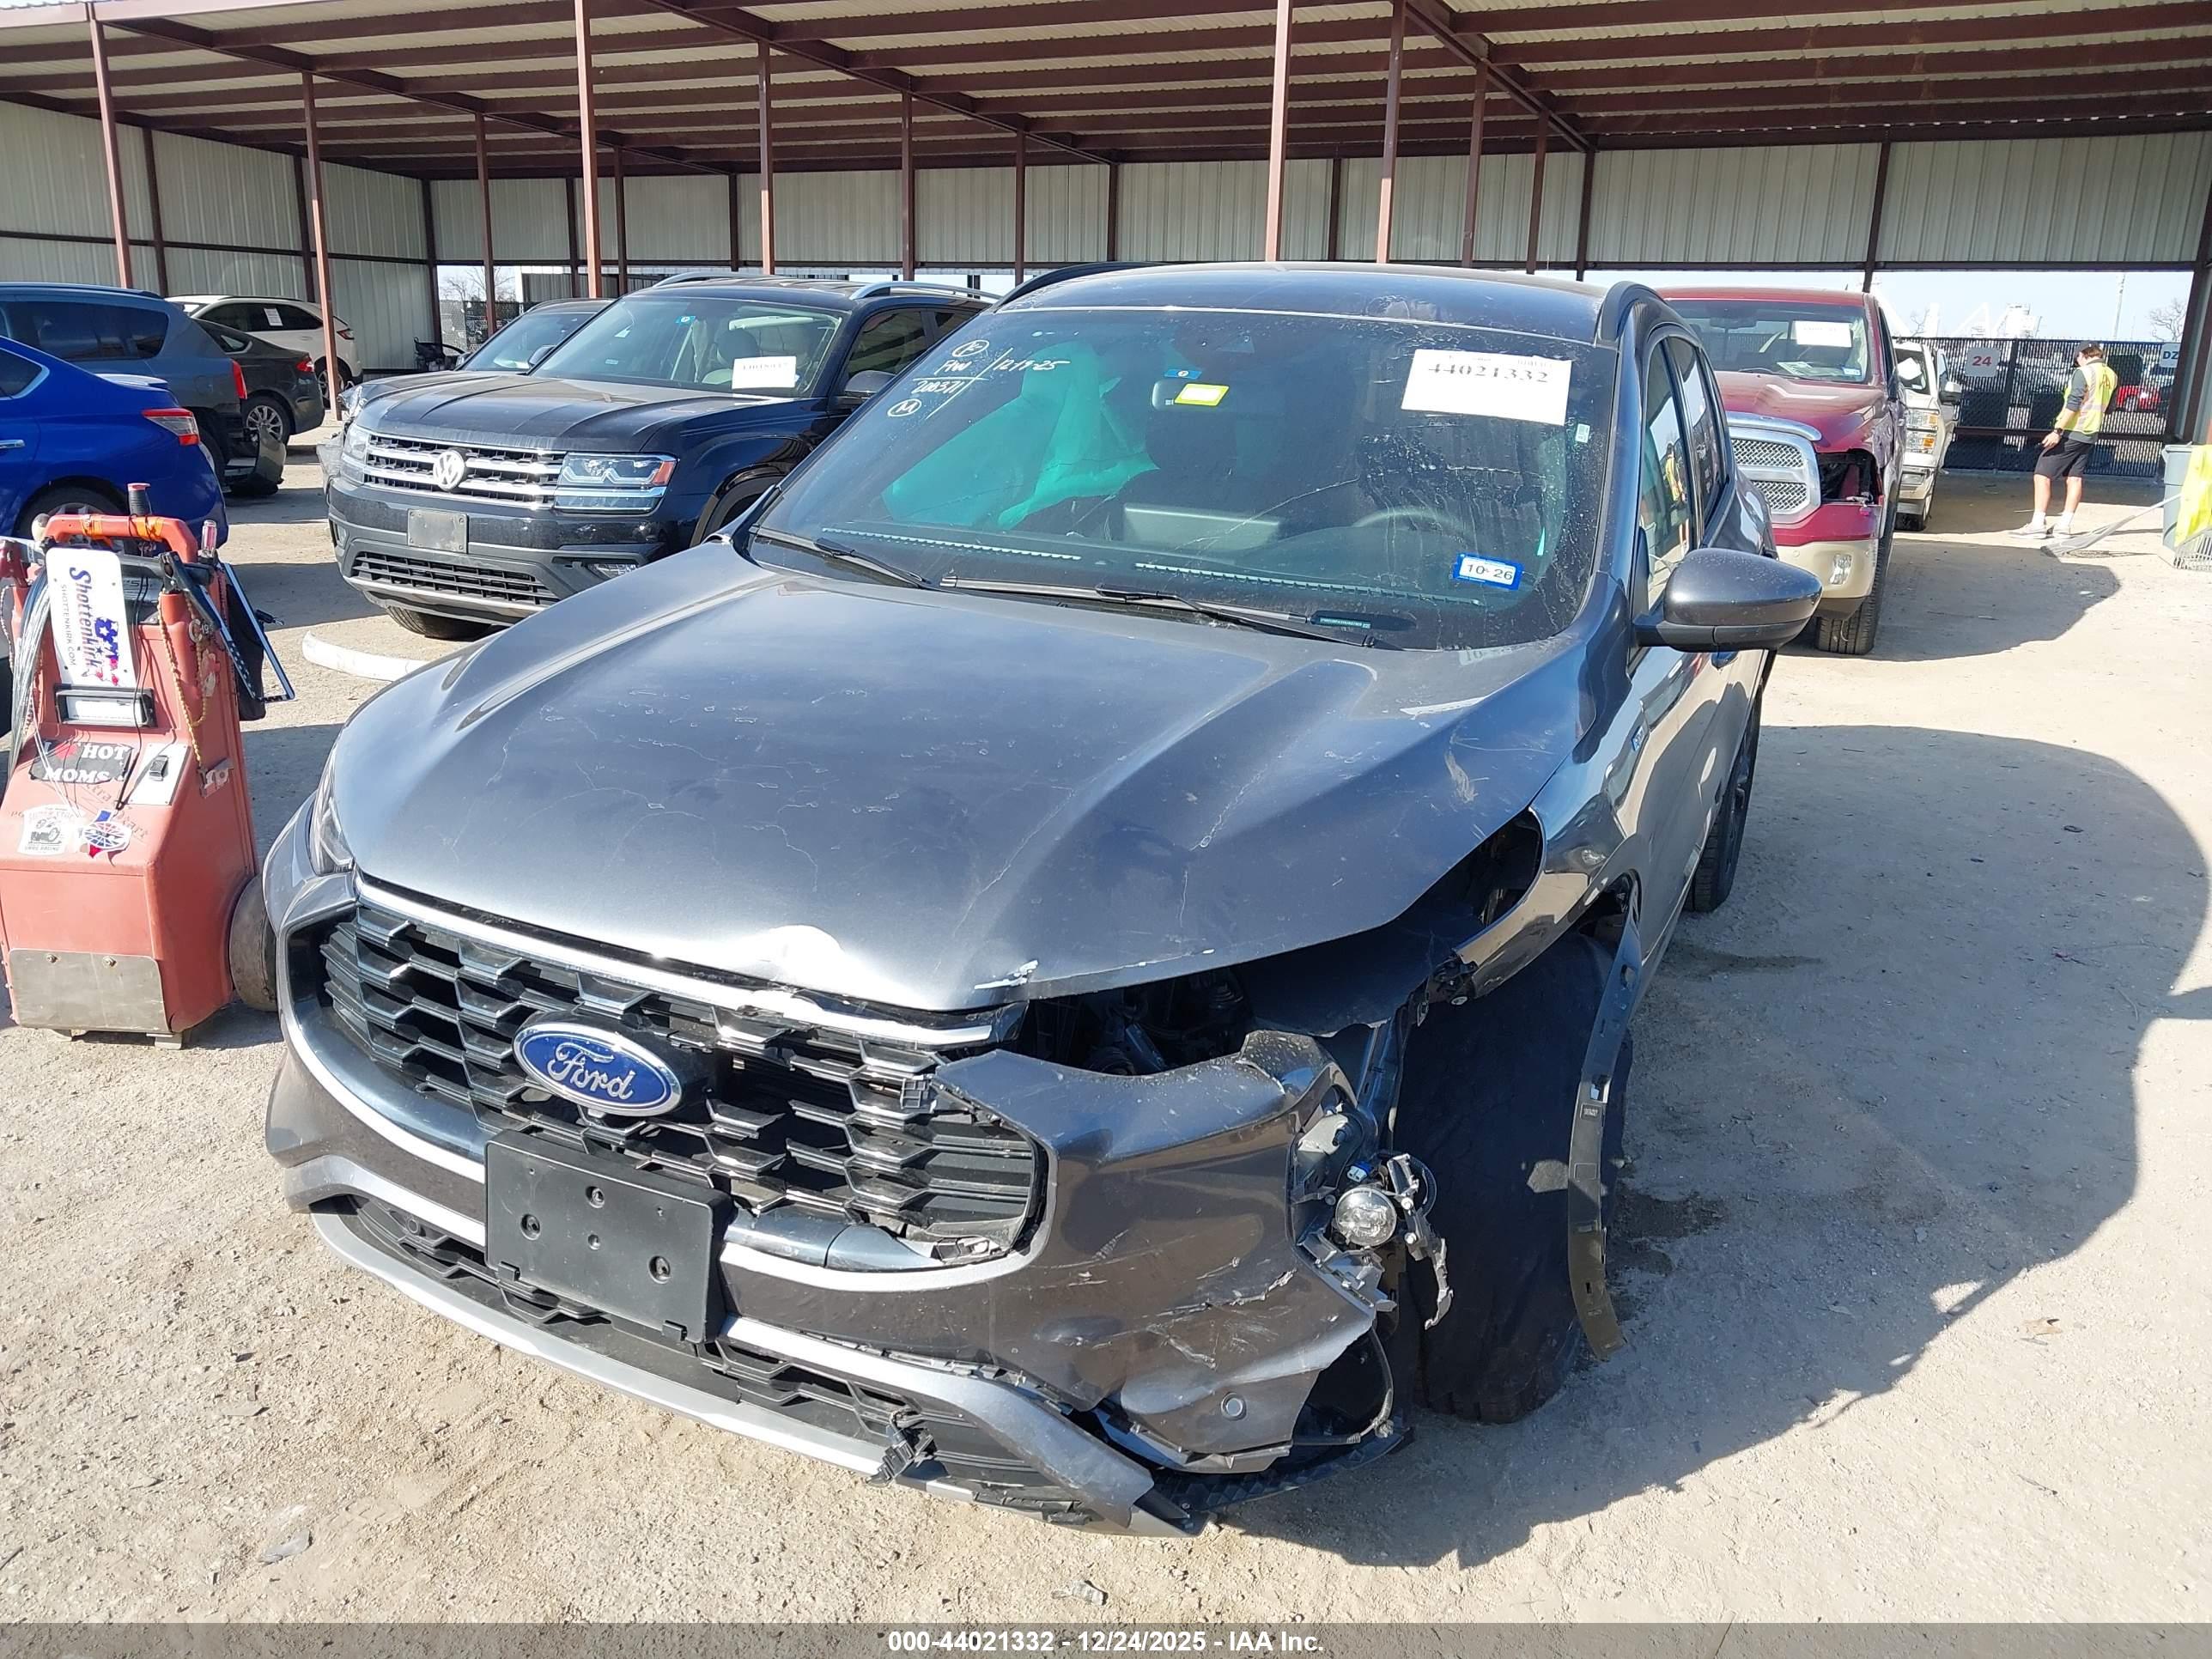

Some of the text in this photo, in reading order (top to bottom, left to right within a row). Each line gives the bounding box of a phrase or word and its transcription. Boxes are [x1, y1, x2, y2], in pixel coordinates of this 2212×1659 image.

[1972, 356, 1993, 367] 24
[1428, 363, 1548, 383] 44021332
[70, 567, 102, 668] Shottenkirk
[81, 744, 131, 760] HOT
[42, 769, 110, 782] MOMS
[547, 1042, 636, 1100] Ford
